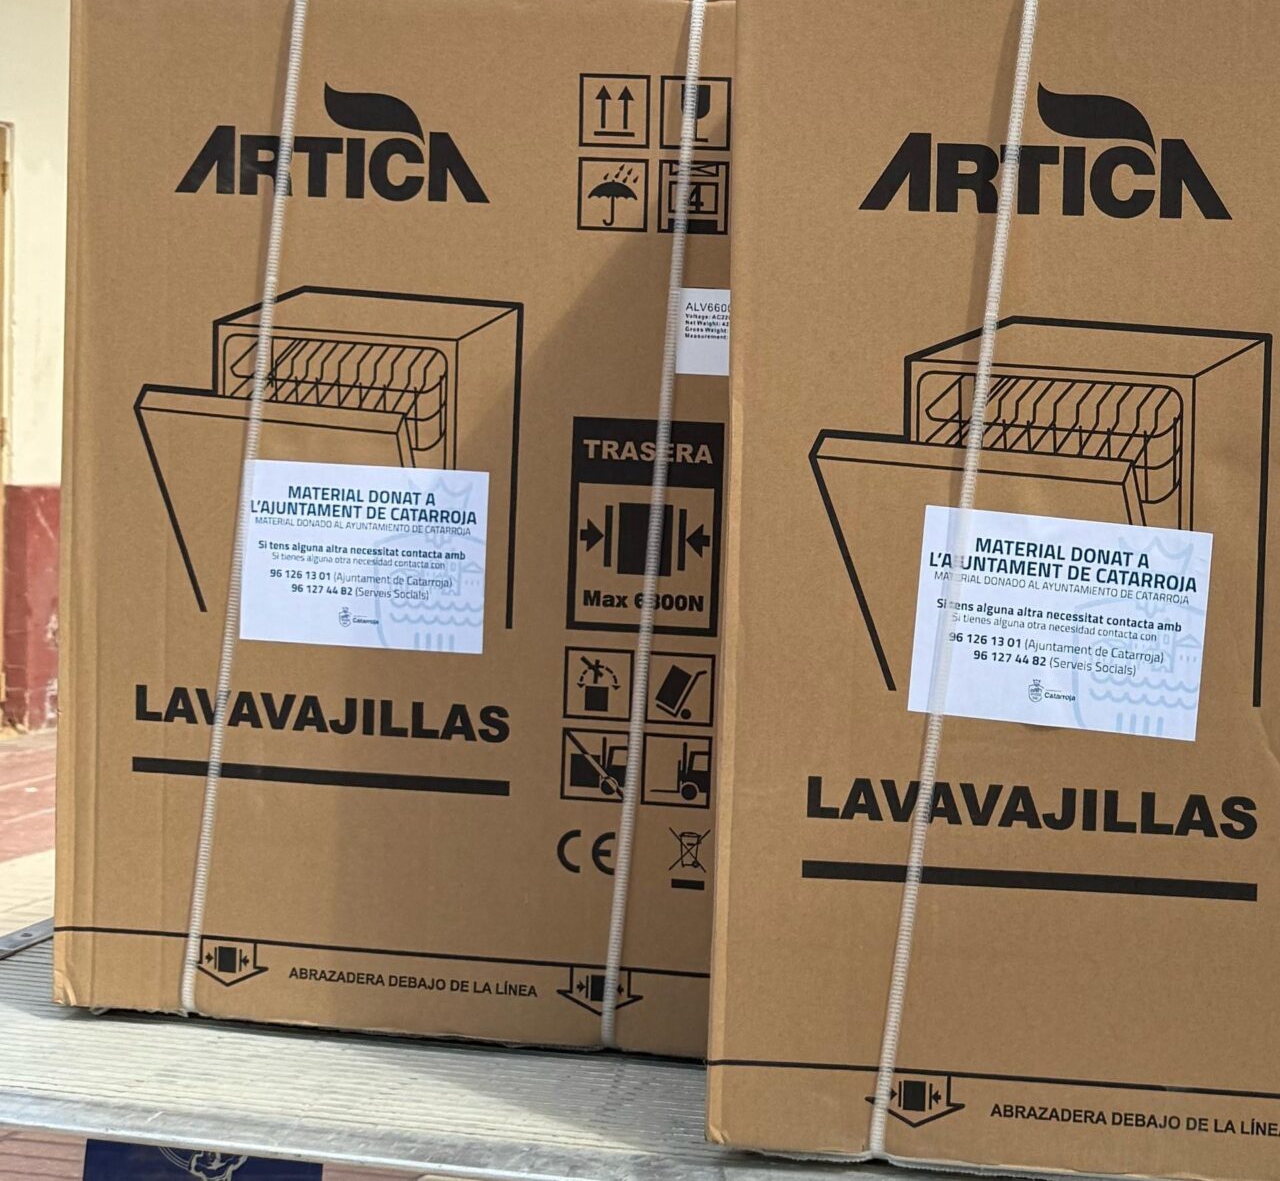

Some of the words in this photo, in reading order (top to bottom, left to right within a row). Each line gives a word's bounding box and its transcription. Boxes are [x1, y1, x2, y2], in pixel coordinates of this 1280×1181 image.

[174, 125, 490, 204] ARTICA
[858, 132, 1233, 220] ARTICA
[688, 183, 704, 212] 4
[288, 486, 364, 503] MATERIAL
[369, 490, 422, 506] DONAT
[425, 493, 436, 506] A
[366, 506, 387, 520] DE
[390, 508, 477, 525] CATARROJA
[975, 537, 1066, 561] MATERIAL
[1071, 547, 1134, 567] DONAT
[1137, 553, 1150, 569] A
[929, 551, 1064, 579] L'AUNTAMENT
[1067, 564, 1090, 581] DE
[1096, 567, 1198, 593] CATARROJA
[583, 590, 628, 608] Max
[135, 684, 510, 743] LAVAVAJILLAS
[806, 775, 1258, 840] LAVAVAJILLAS
[288, 967, 385, 986] ABRAZADERA
[389, 975, 446, 991] DEBAJO
[450, 979, 469, 993] DE
[473, 982, 492, 995] LA
[496, 981, 537, 998] LÍNEA
[990, 1103, 1107, 1126] ABRAZADERA
[1111, 1111, 1181, 1131] DEBAJO
[1185, 1117, 1209, 1132] DE
[1214, 1119, 1236, 1134] LA
